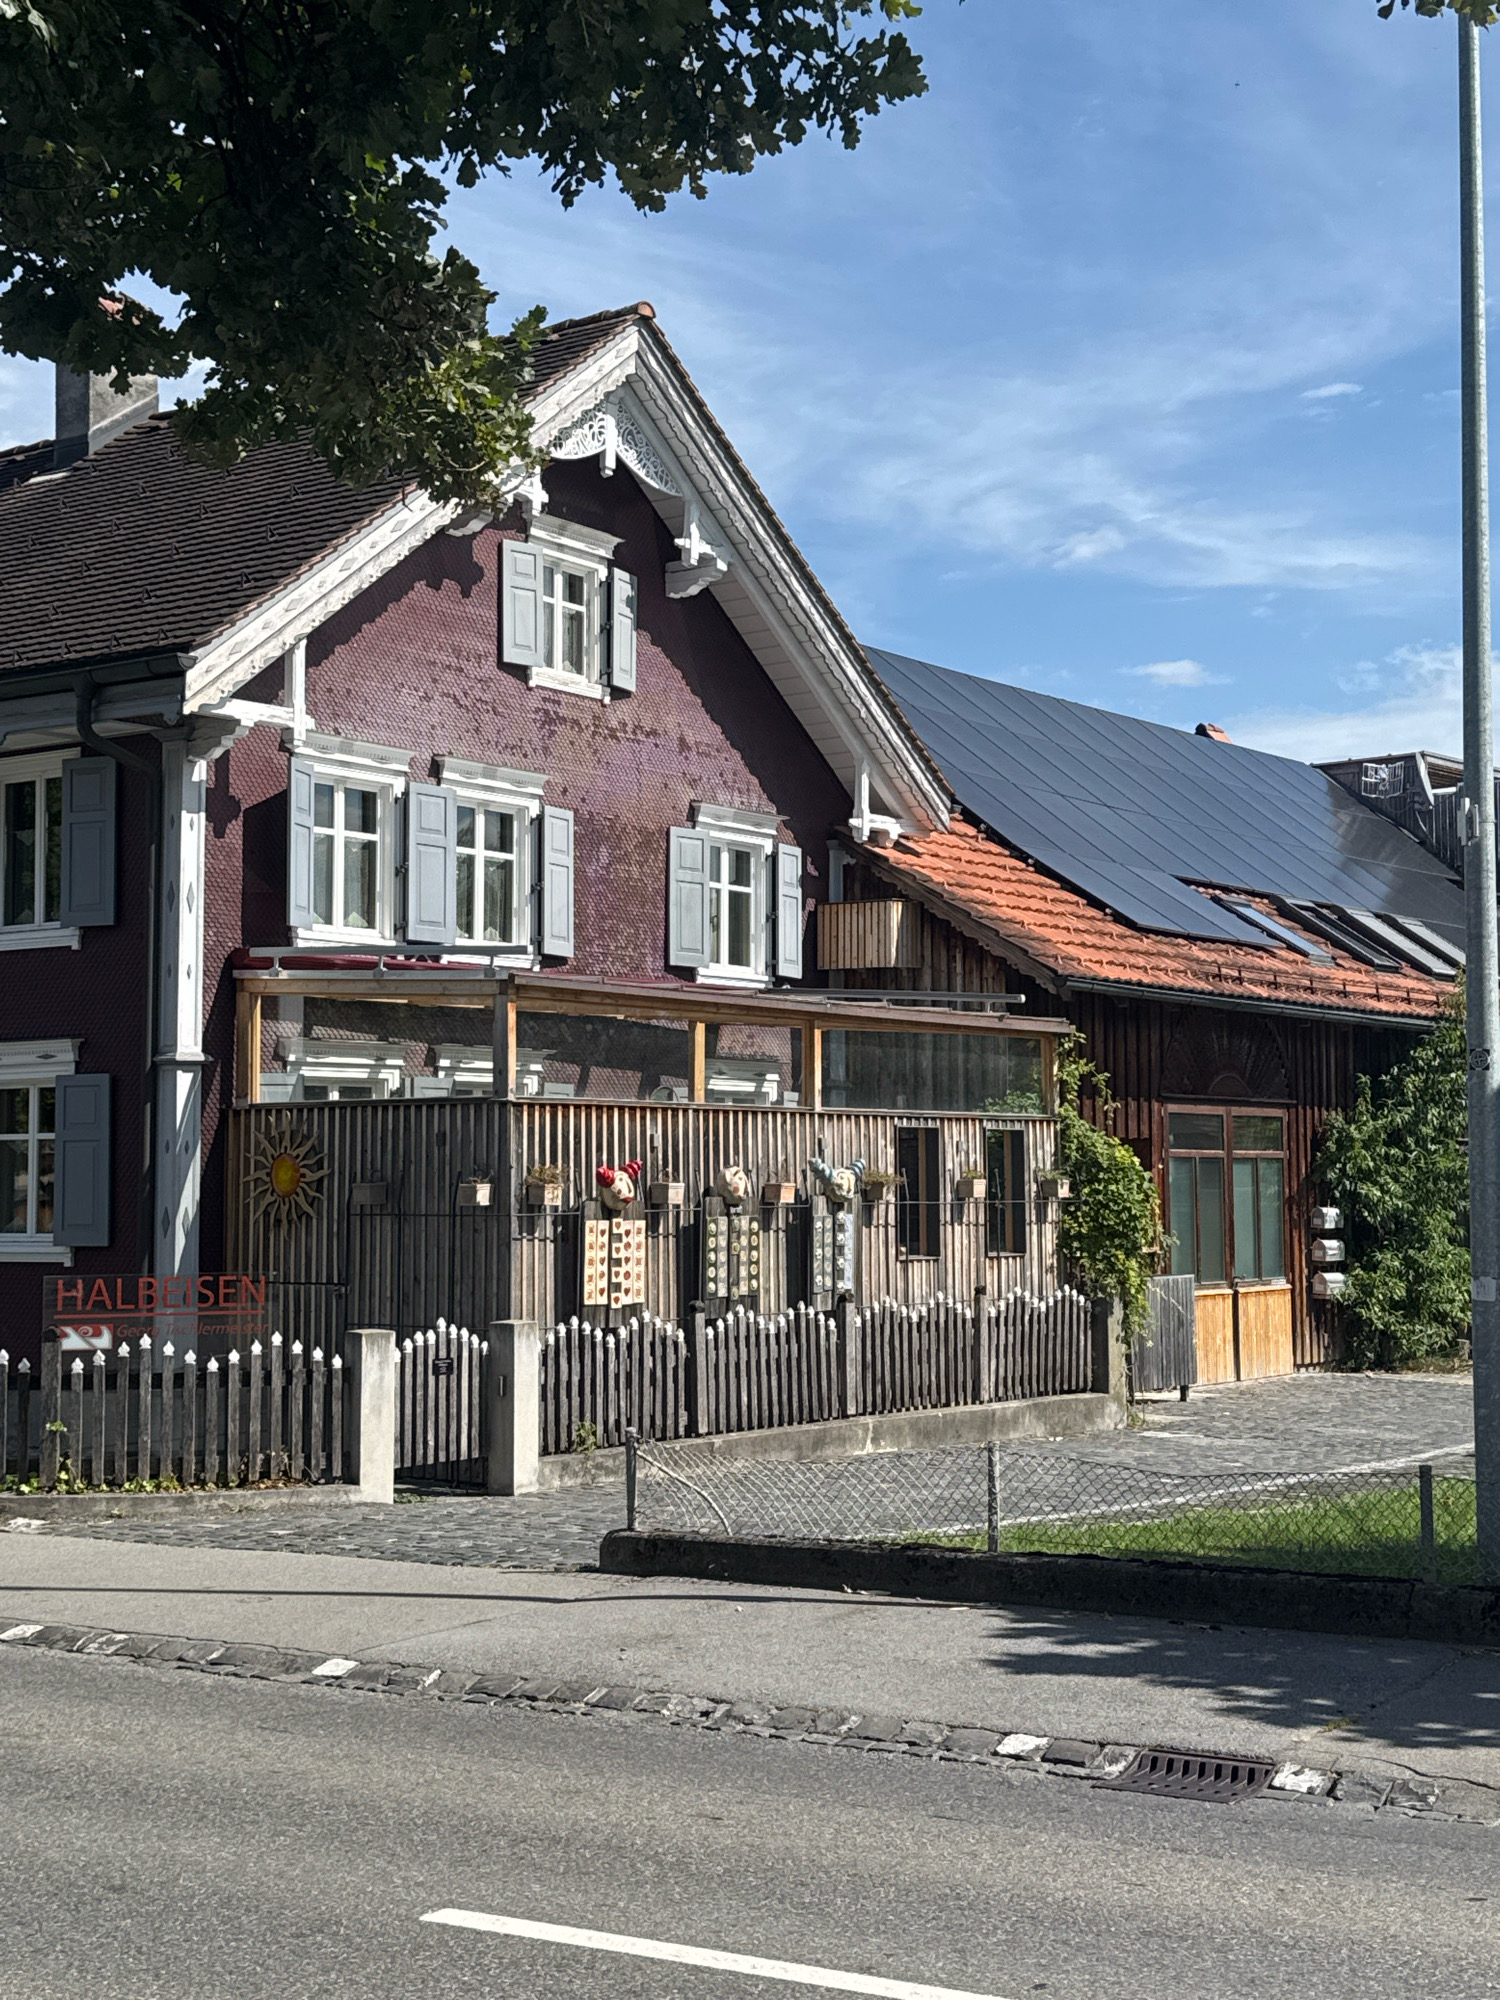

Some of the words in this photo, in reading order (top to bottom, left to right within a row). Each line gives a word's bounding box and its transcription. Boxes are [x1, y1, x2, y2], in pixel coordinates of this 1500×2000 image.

[57, 1275, 266, 1311] HALBEISEN
[117, 1324, 160, 1338] Georg
[166, 1321, 268, 1337] Tischlermeister
